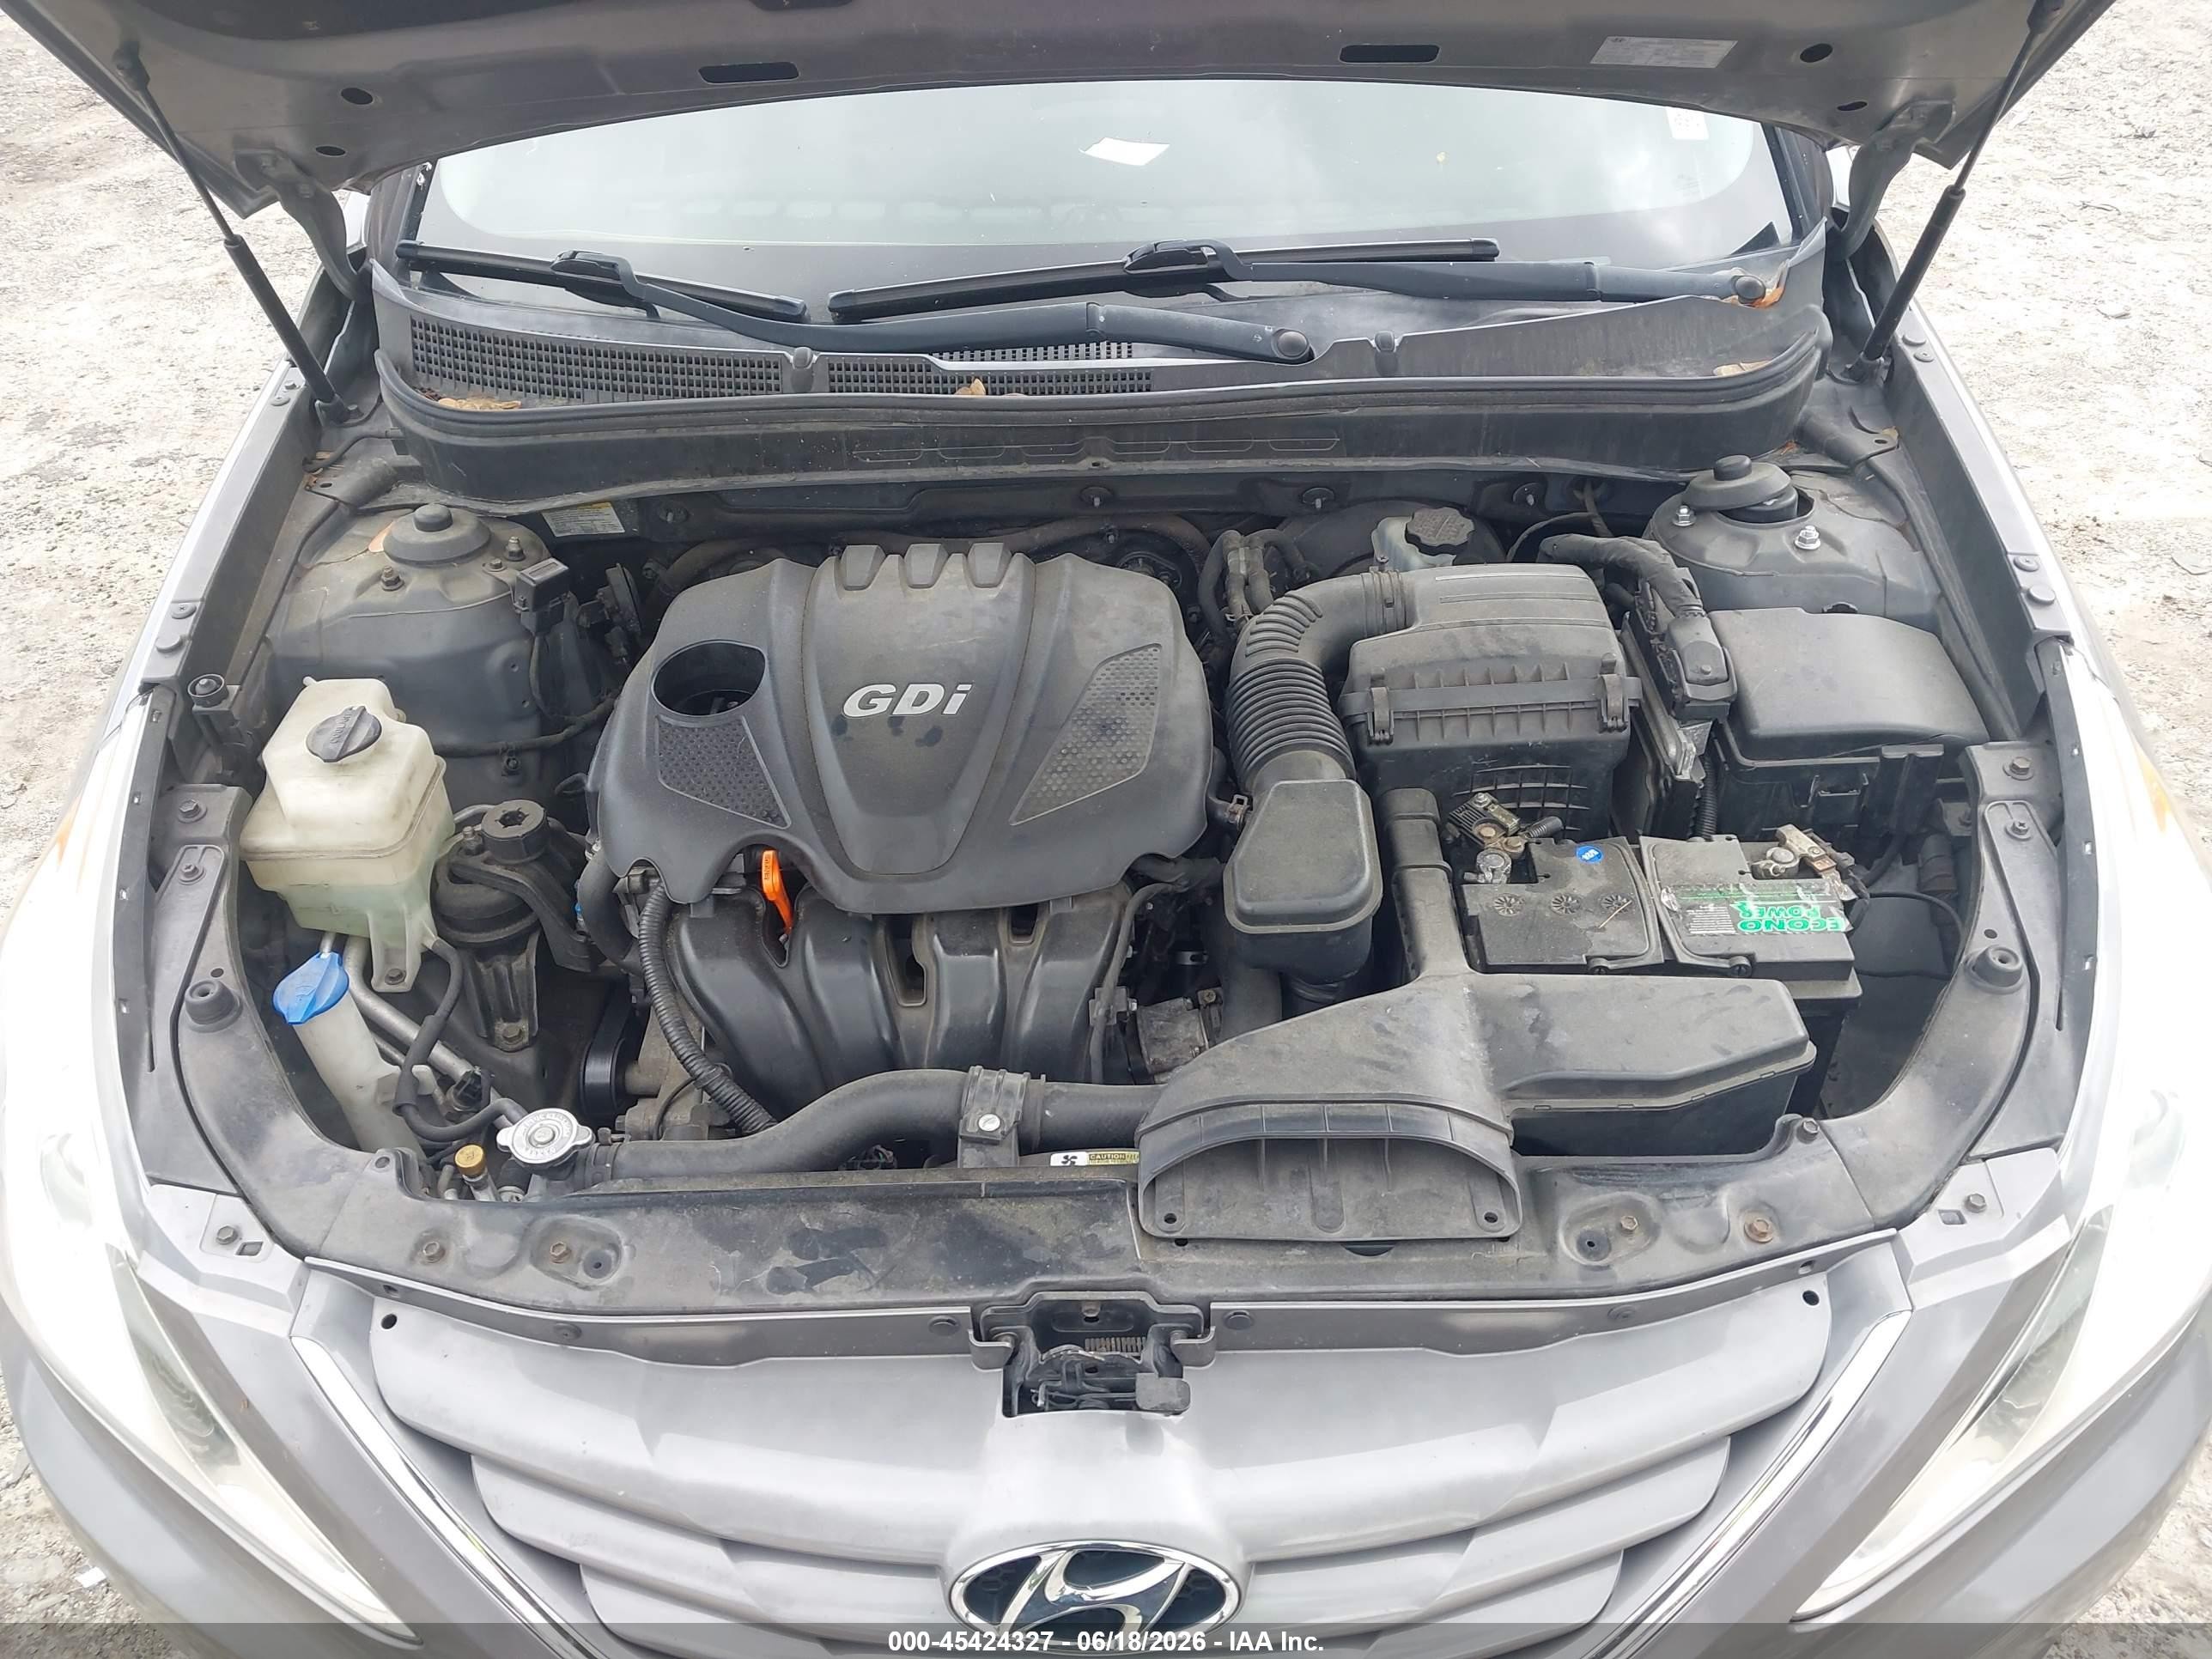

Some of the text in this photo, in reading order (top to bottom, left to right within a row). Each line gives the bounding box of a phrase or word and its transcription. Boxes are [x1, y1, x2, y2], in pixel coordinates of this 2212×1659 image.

[842, 684, 973, 718] GDi
[1731, 902, 1821, 918] POWER
[1737, 916, 1846, 933] ECONO
